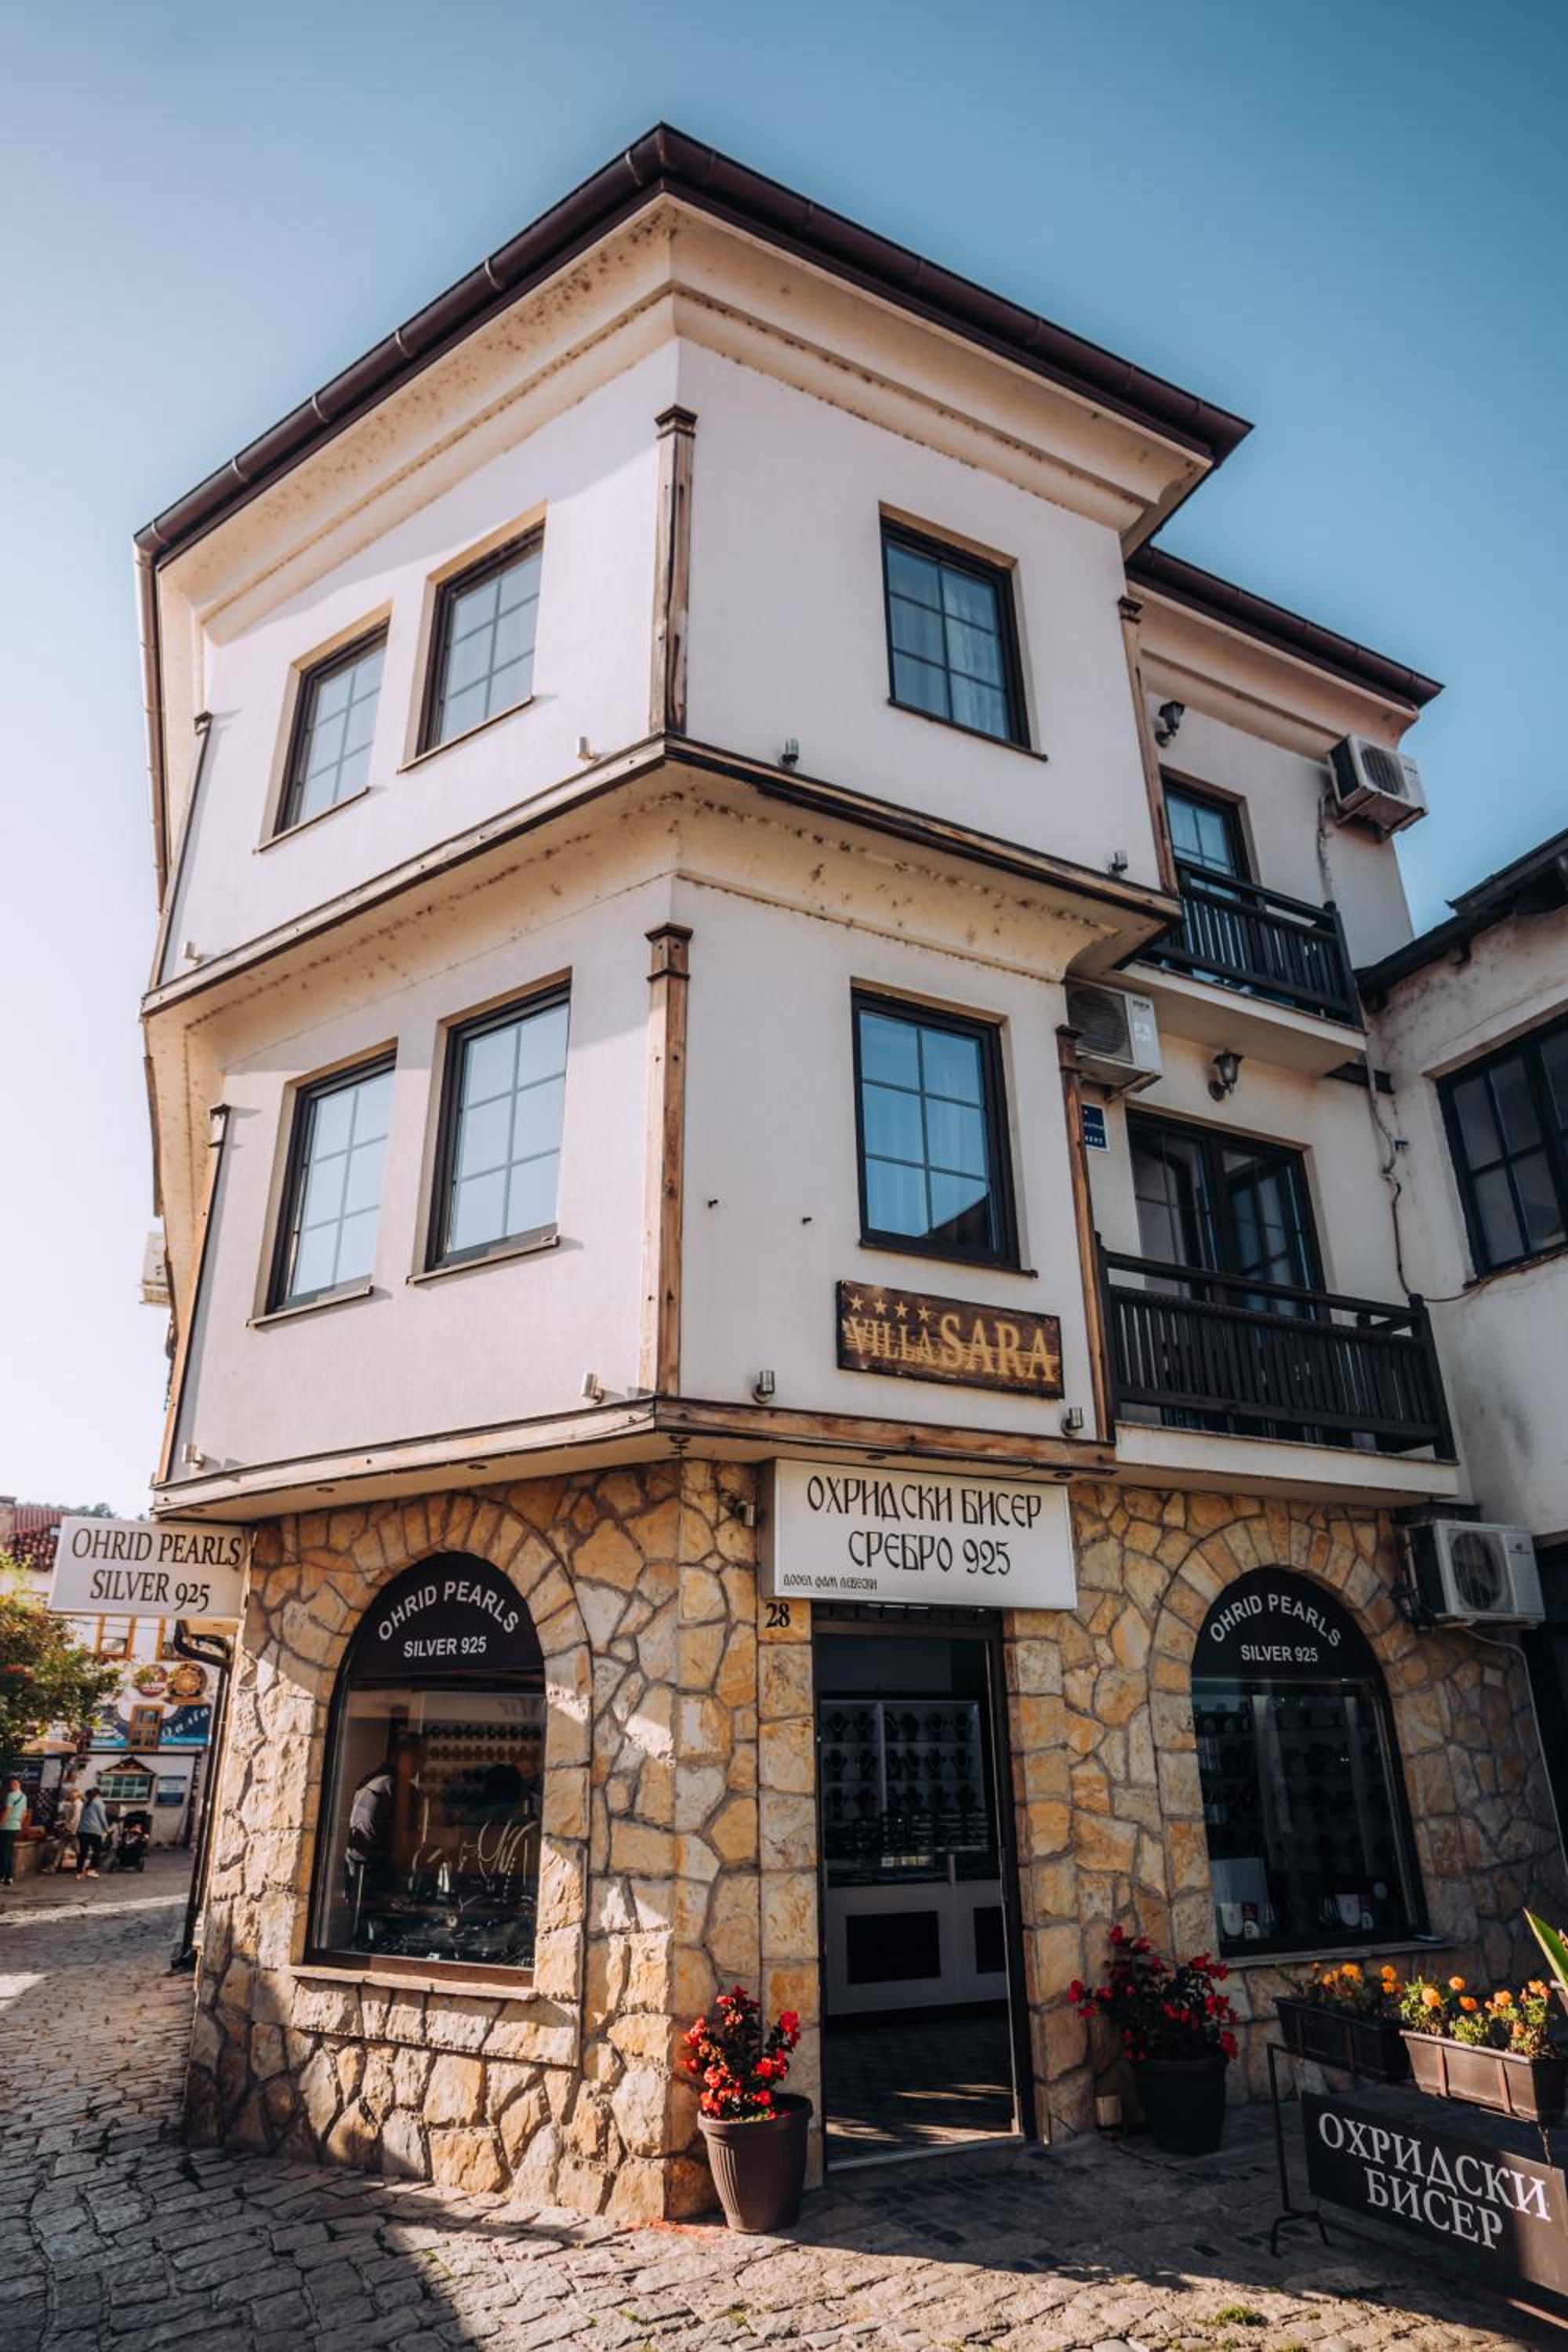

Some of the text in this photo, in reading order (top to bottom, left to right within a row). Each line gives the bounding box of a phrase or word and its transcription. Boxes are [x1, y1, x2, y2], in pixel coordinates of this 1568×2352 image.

[848, 1312, 1055, 1382] VILLA SARA
[807, 1475, 1041, 1529] ОХРИДСКИ БИСЕР
[72, 1528, 241, 1567] OHRID PEARLS
[848, 1530, 1011, 1576] СРЕБРО 925
[89, 1570, 210, 1613] SILVER 925
[379, 1581, 519, 1641] OHRID PEARLS
[765, 1602, 790, 1628] 28
[1210, 1594, 1341, 1646] OHRID PEARLS
[403, 1636, 487, 1657] SILVER 925
[1240, 1644, 1318, 1662] SILVER 925
[1319, 2112, 1551, 2223] ОХРИДСКИ
[1364, 2166, 1503, 2249] БИСЕР
